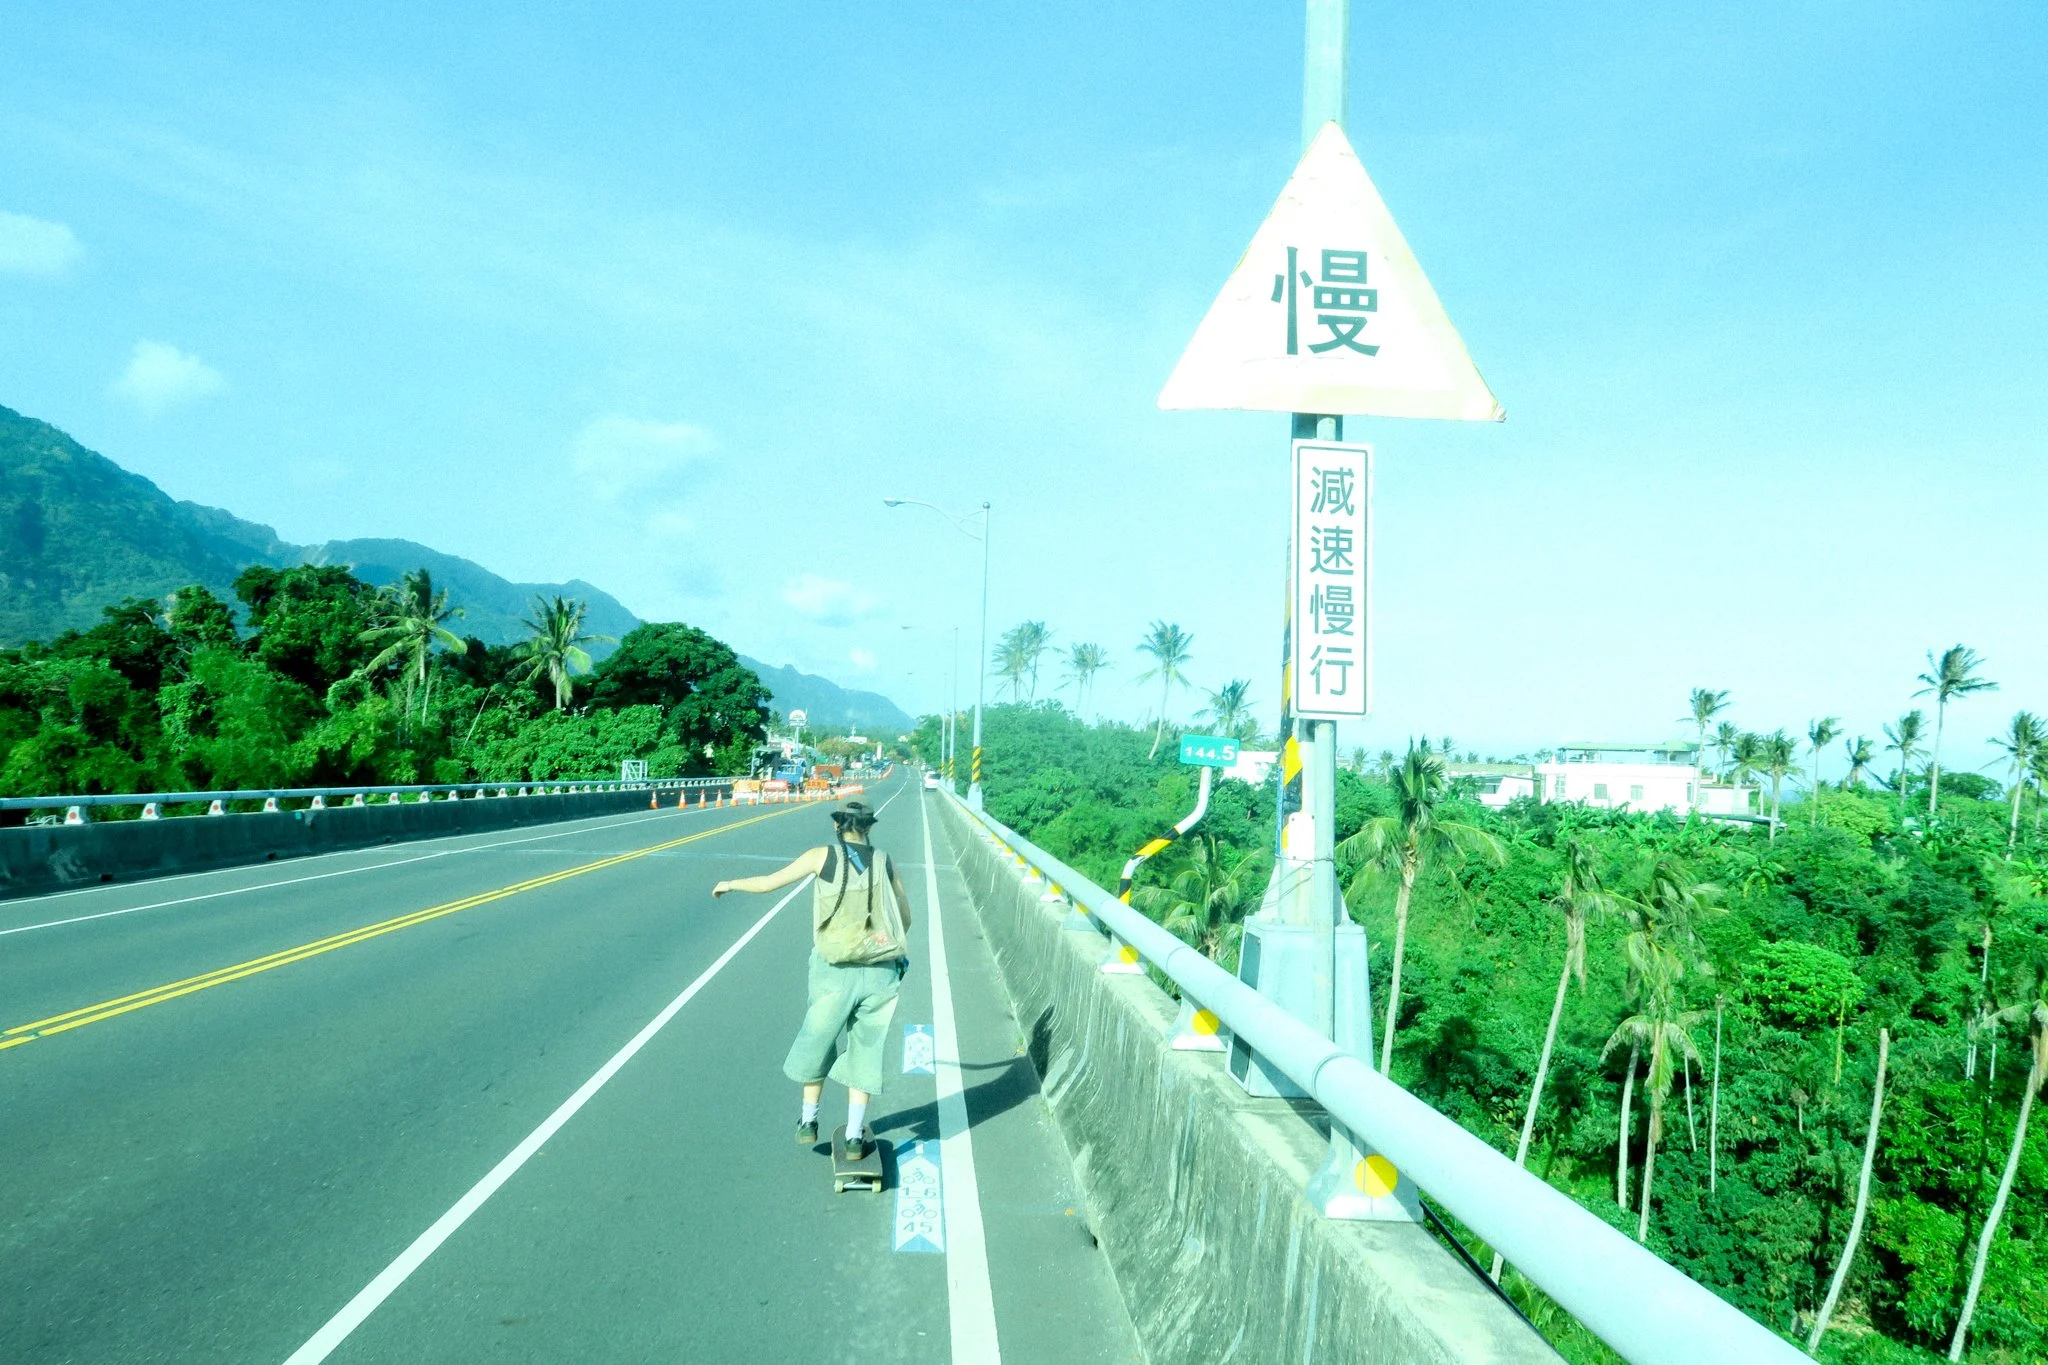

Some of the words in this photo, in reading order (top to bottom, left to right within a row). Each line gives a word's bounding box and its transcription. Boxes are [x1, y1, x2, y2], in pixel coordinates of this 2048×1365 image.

[1271, 246, 1380, 357] 慢
[1309, 466, 1355, 697] 減速慢行
